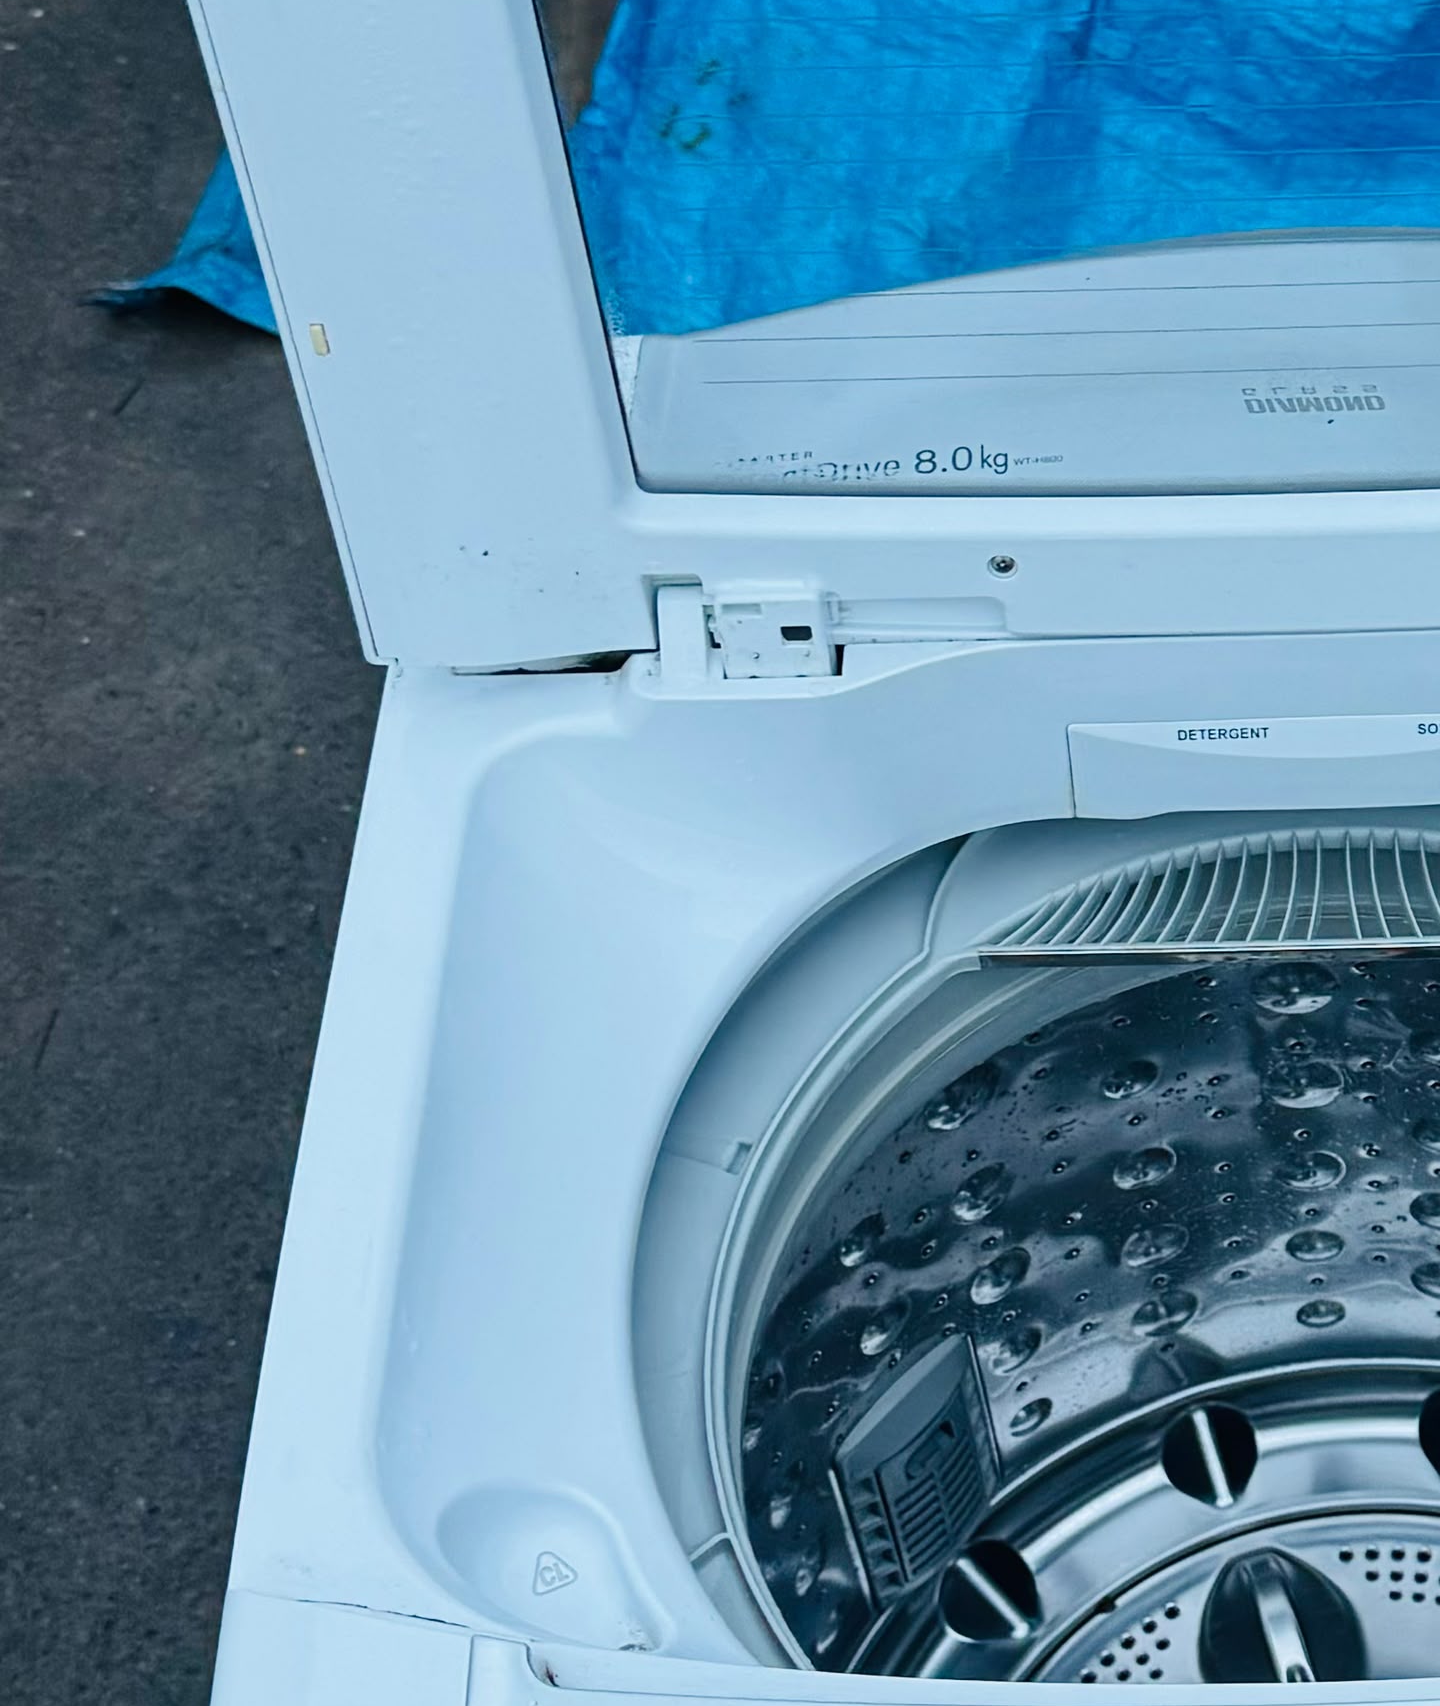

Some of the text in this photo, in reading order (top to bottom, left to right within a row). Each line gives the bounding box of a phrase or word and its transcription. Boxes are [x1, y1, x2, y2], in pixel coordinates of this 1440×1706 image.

[914, 446, 973, 475] 8.0
[980, 444, 1009, 475] kg
[1177, 726, 1270, 741] DETERGENT
